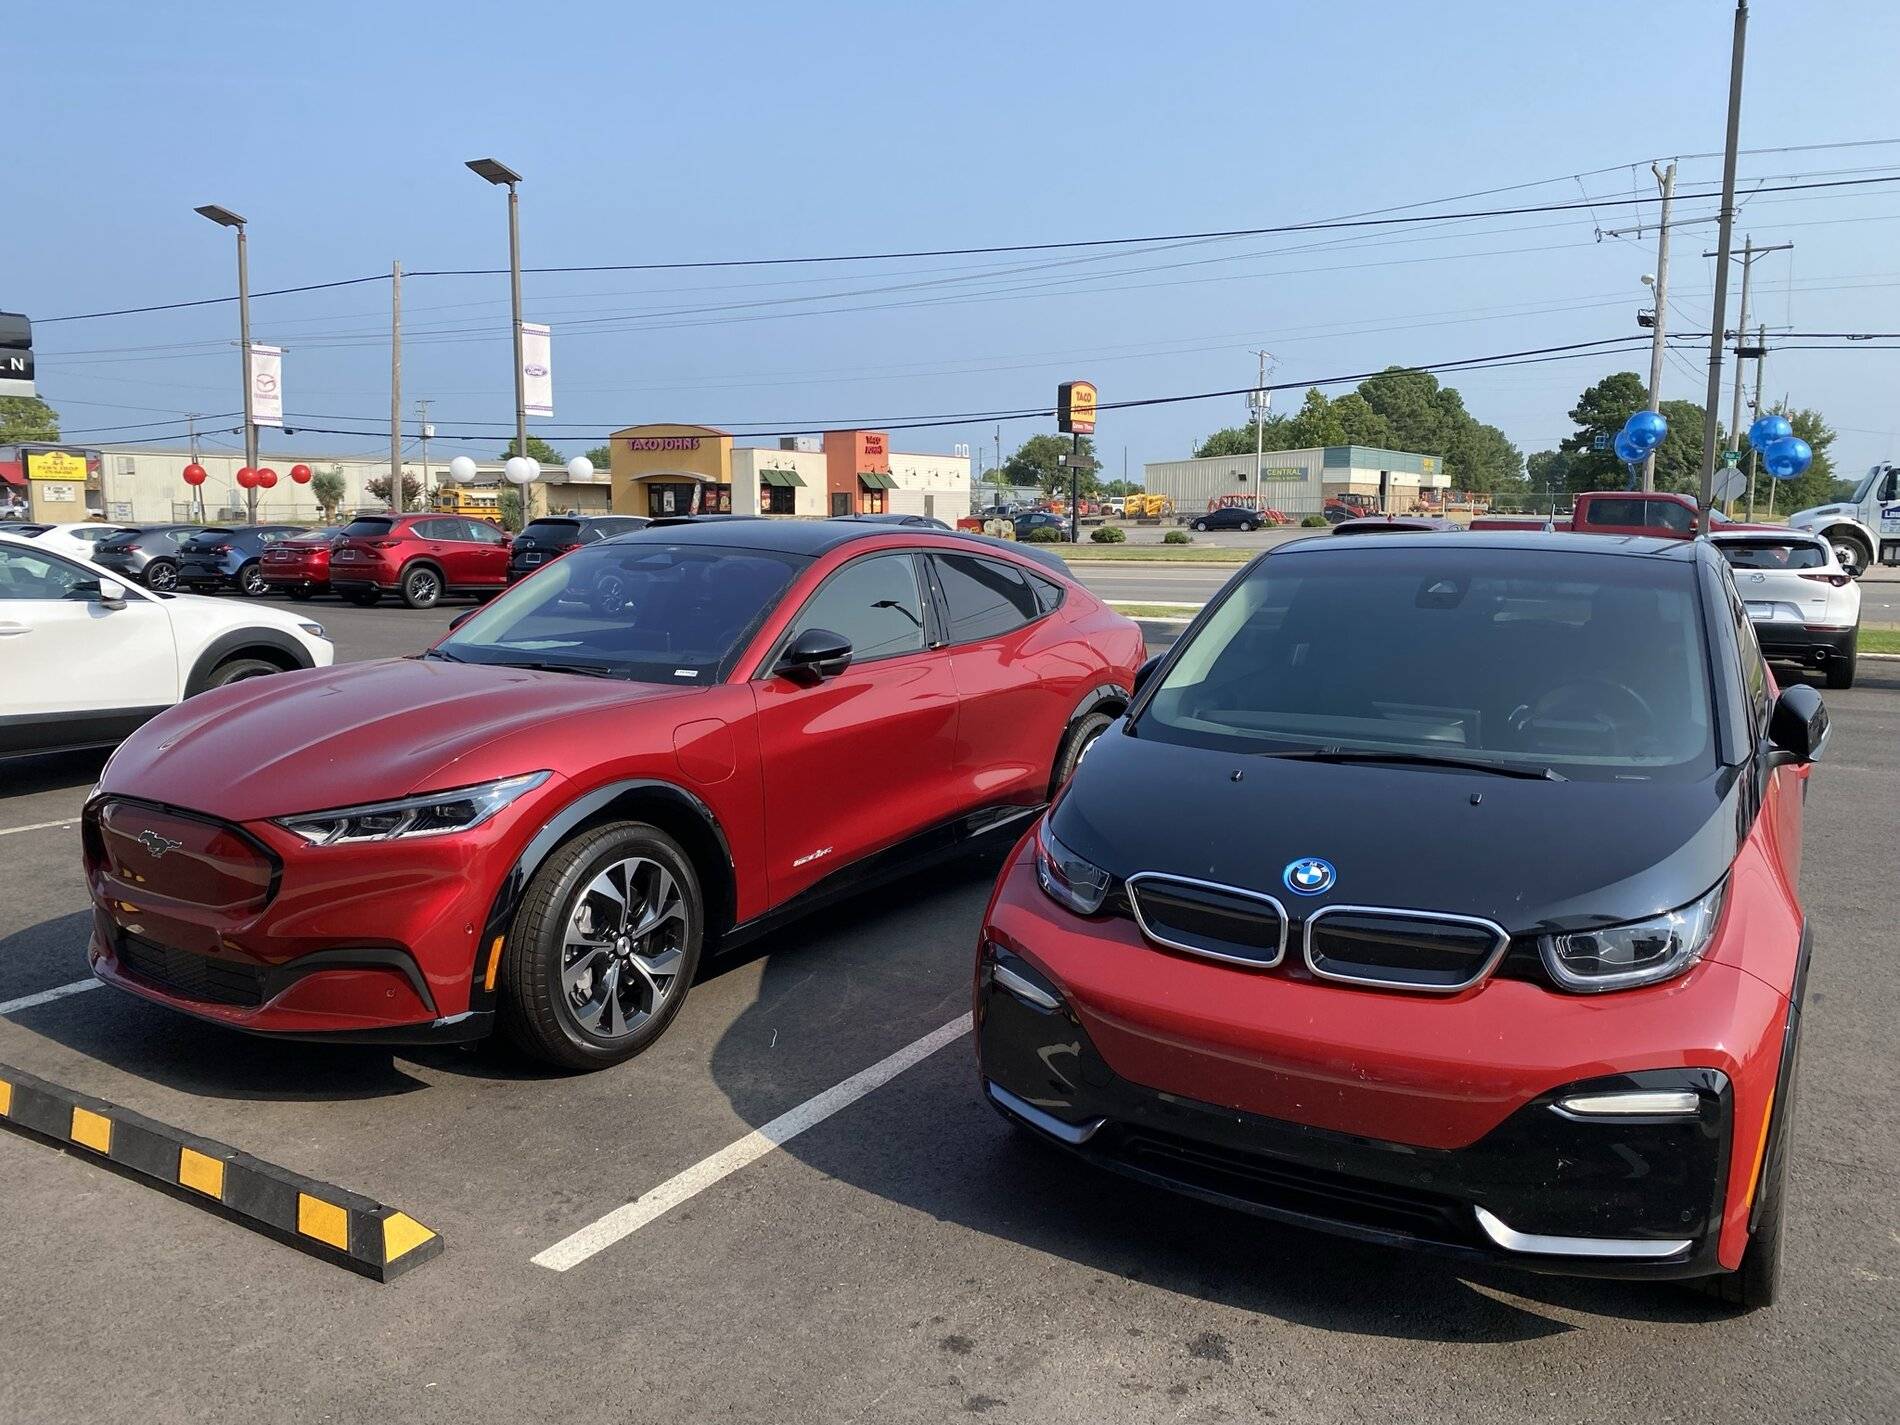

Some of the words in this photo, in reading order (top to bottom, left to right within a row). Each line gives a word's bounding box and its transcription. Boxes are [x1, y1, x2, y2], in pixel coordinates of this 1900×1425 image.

[1076, 391, 1092, 403] TACO
[627, 439, 659, 450] TACO
[1266, 468, 1302, 476] CENTRAL
